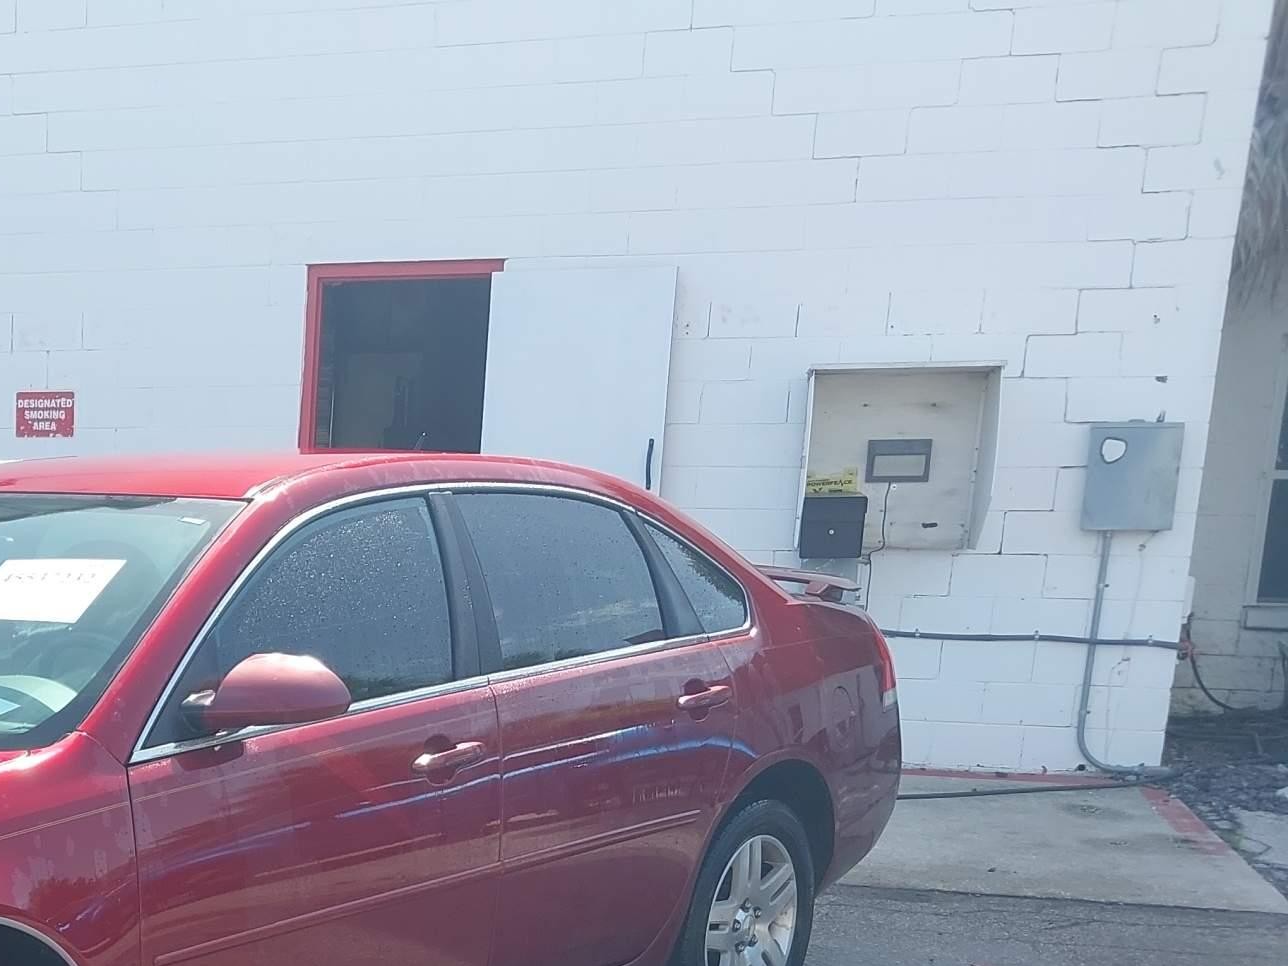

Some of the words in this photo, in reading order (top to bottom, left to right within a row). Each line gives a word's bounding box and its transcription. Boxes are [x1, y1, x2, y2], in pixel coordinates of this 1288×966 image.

[18, 399, 72, 408] DESIGNATED
[24, 410, 66, 420] SMOKING
[33, 422, 56, 430] AREA
